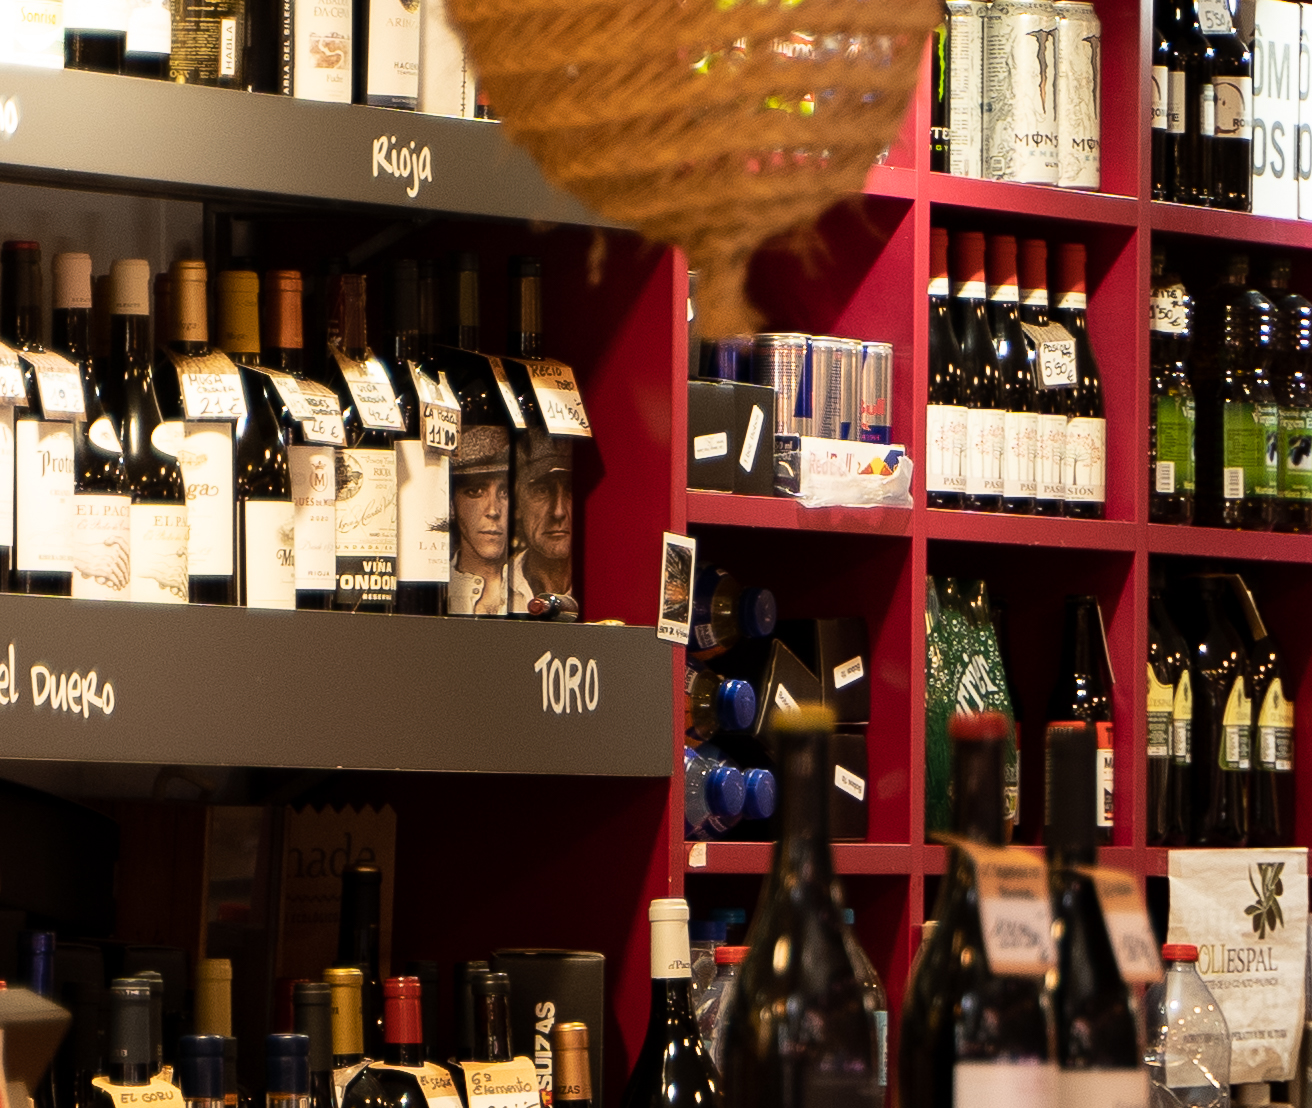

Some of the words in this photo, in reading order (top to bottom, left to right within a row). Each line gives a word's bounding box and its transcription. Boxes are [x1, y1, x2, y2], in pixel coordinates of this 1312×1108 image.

[225, 26, 236, 71] HABLA
[373, 136, 432, 198] Rioja
[200, 398, 226, 414] 21
[186, 482, 219, 503] ga
[76, 504, 97, 516] EL
[154, 515, 175, 527] EL
[362, 558, 393, 573] VIÑA
[535, 651, 599, 715] TORO
[1198, 944, 1278, 975] OLIESPAL
[473, 1077, 532, 1095] Elemento
[121, 1093, 138, 1103] EL
[142, 1090, 174, 1103] GORU
